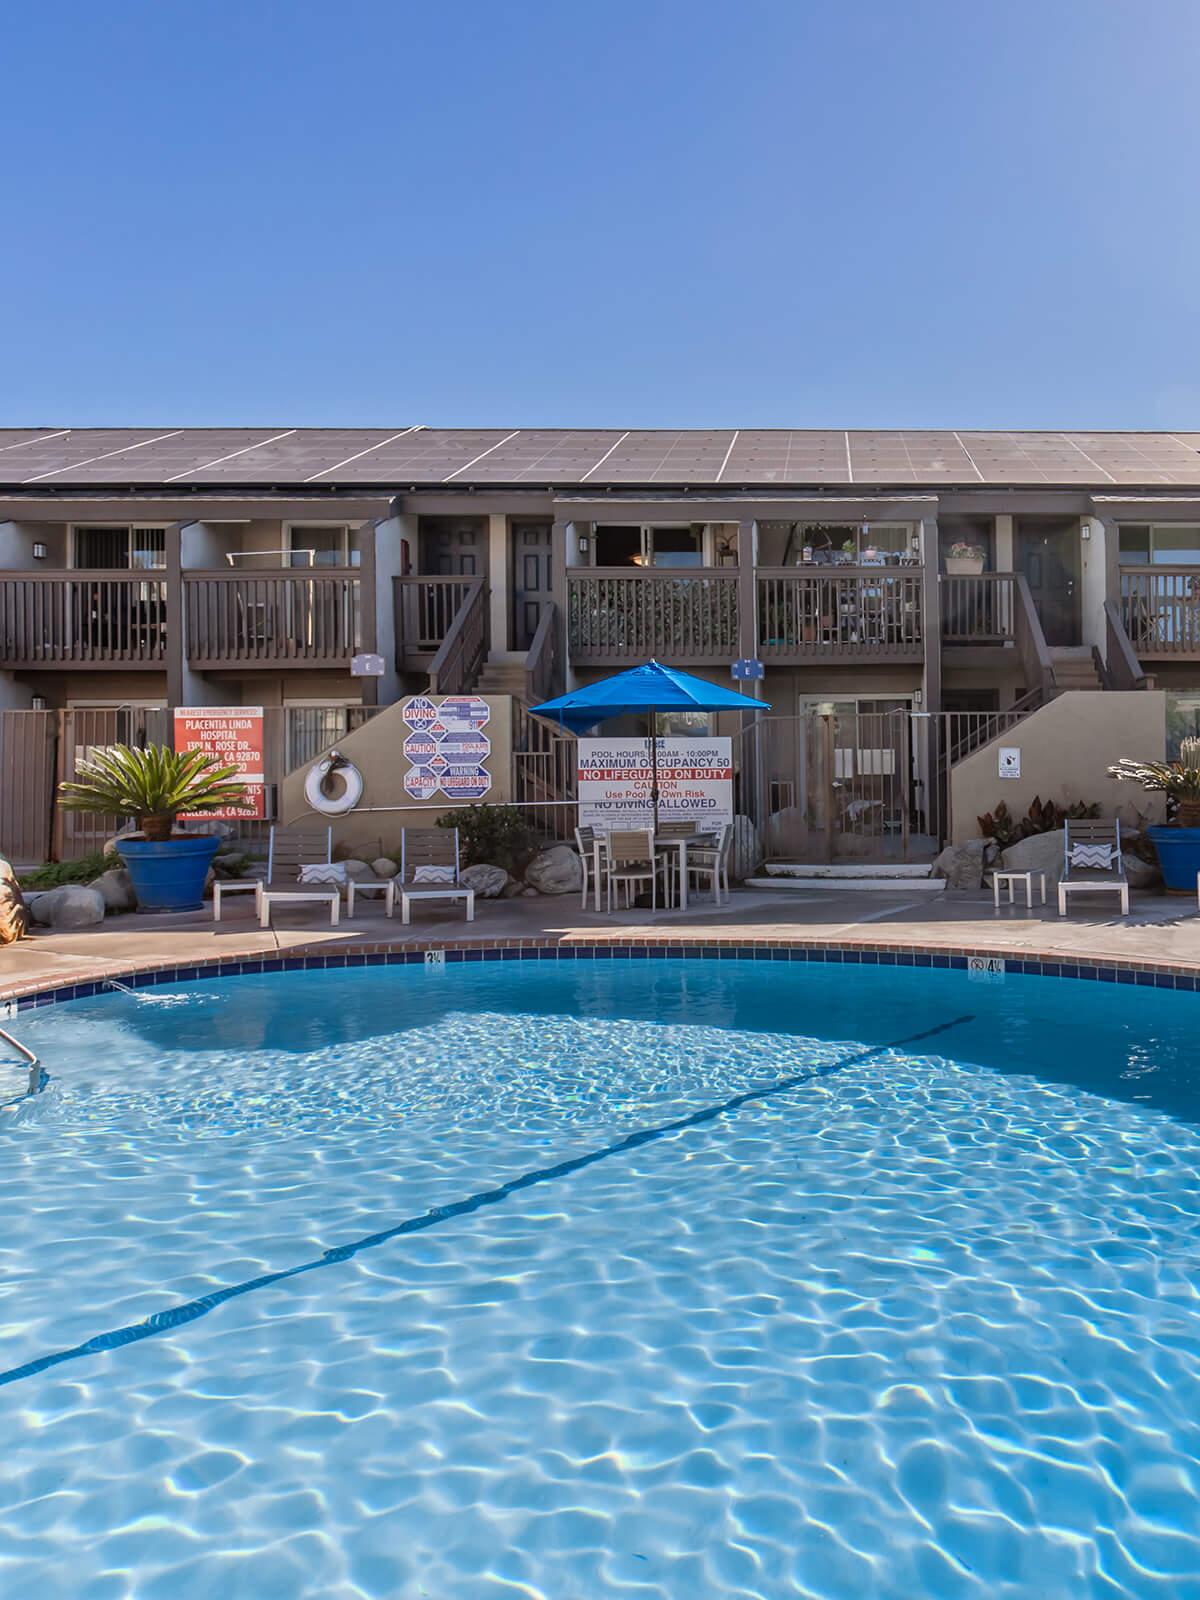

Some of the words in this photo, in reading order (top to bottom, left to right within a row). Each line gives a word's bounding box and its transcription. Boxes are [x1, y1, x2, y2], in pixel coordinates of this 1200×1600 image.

[414, 698, 428, 709] NO
[404, 709, 436, 719] DIVING
[186, 720, 228, 730] PLACENTIA
[229, 720, 252, 729] LINDA
[201, 731, 237, 740] HOSPITAL
[215, 741, 236, 751] ROSE
[405, 743, 436, 753] CAUTION
[224, 752, 234, 761] CA
[237, 752, 260, 761] 92870
[580, 759, 636, 768] MAXIMUM
[640, 758, 713, 768] OCCUPANCY
[717, 758, 730, 767] 50
[450, 767, 480, 776] WARNING
[584, 770, 600, 780] NO
[604, 770, 672, 780] LIFEGUARD
[674, 769, 692, 779] ON
[695, 769, 726, 779] DUTY
[625, 790, 646, 798] Pool
[661, 790, 682, 798] Own
[685, 789, 705, 798] Risk
[616, 800, 654, 808] DIVING
[658, 799, 717, 808] ALLOWED
